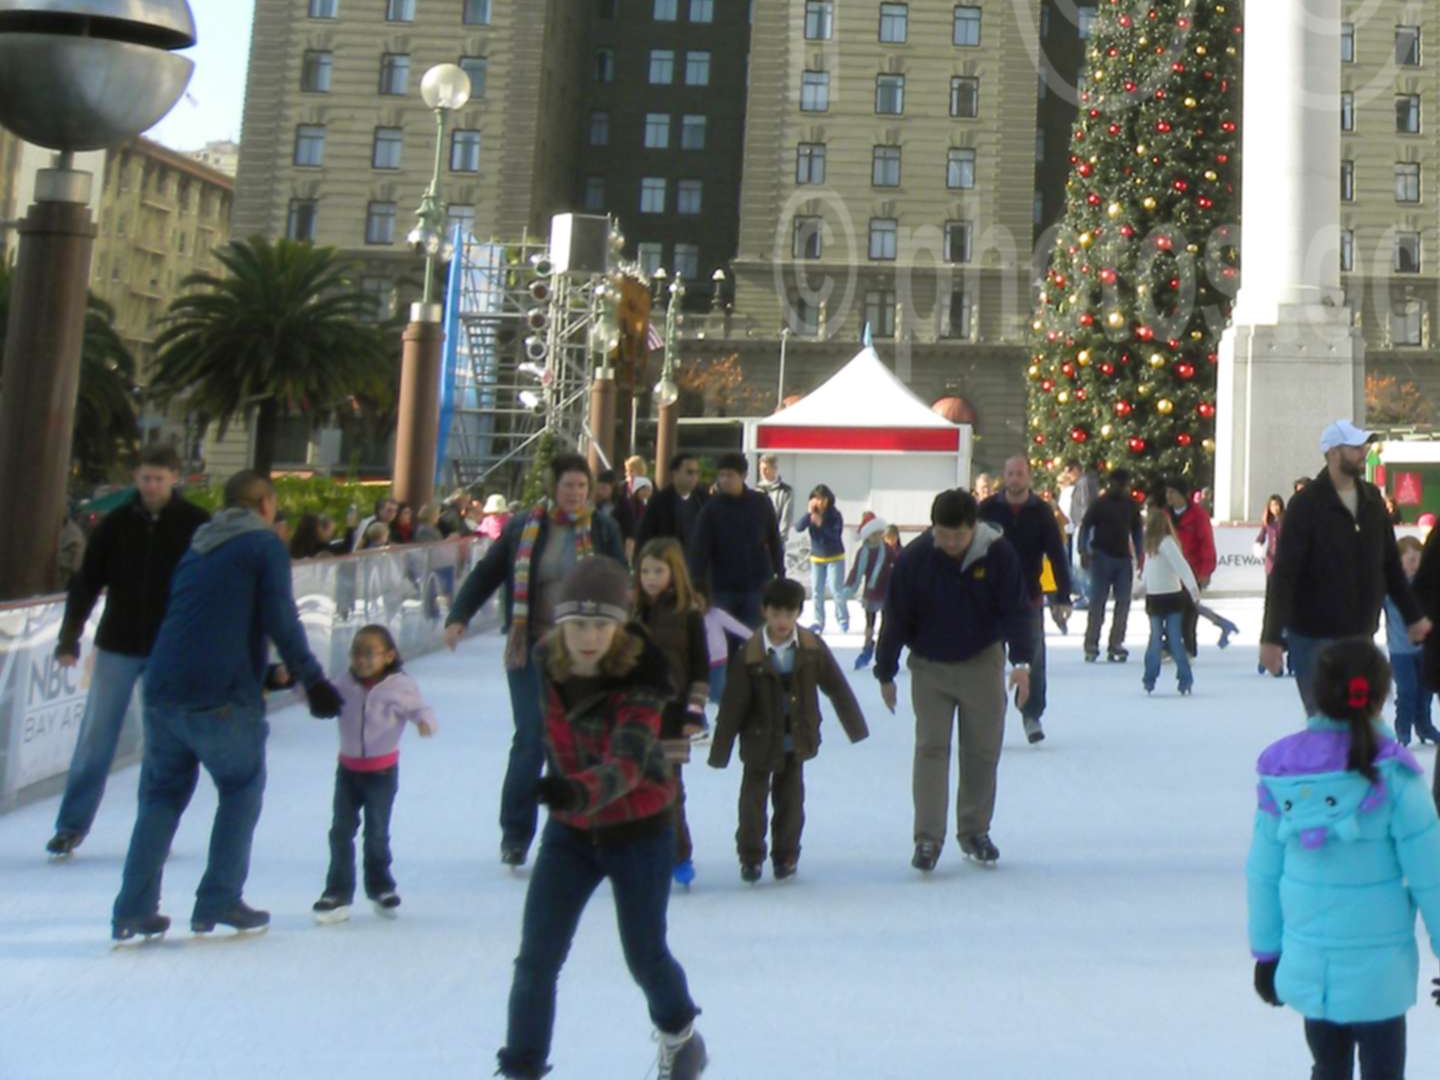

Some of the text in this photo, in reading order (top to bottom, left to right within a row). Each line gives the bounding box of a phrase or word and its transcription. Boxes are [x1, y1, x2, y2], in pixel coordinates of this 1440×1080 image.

[1218, 553, 1266, 567] AFEWAY
[28, 655, 76, 707] NBC
[24, 701, 84, 743] BAY AR
